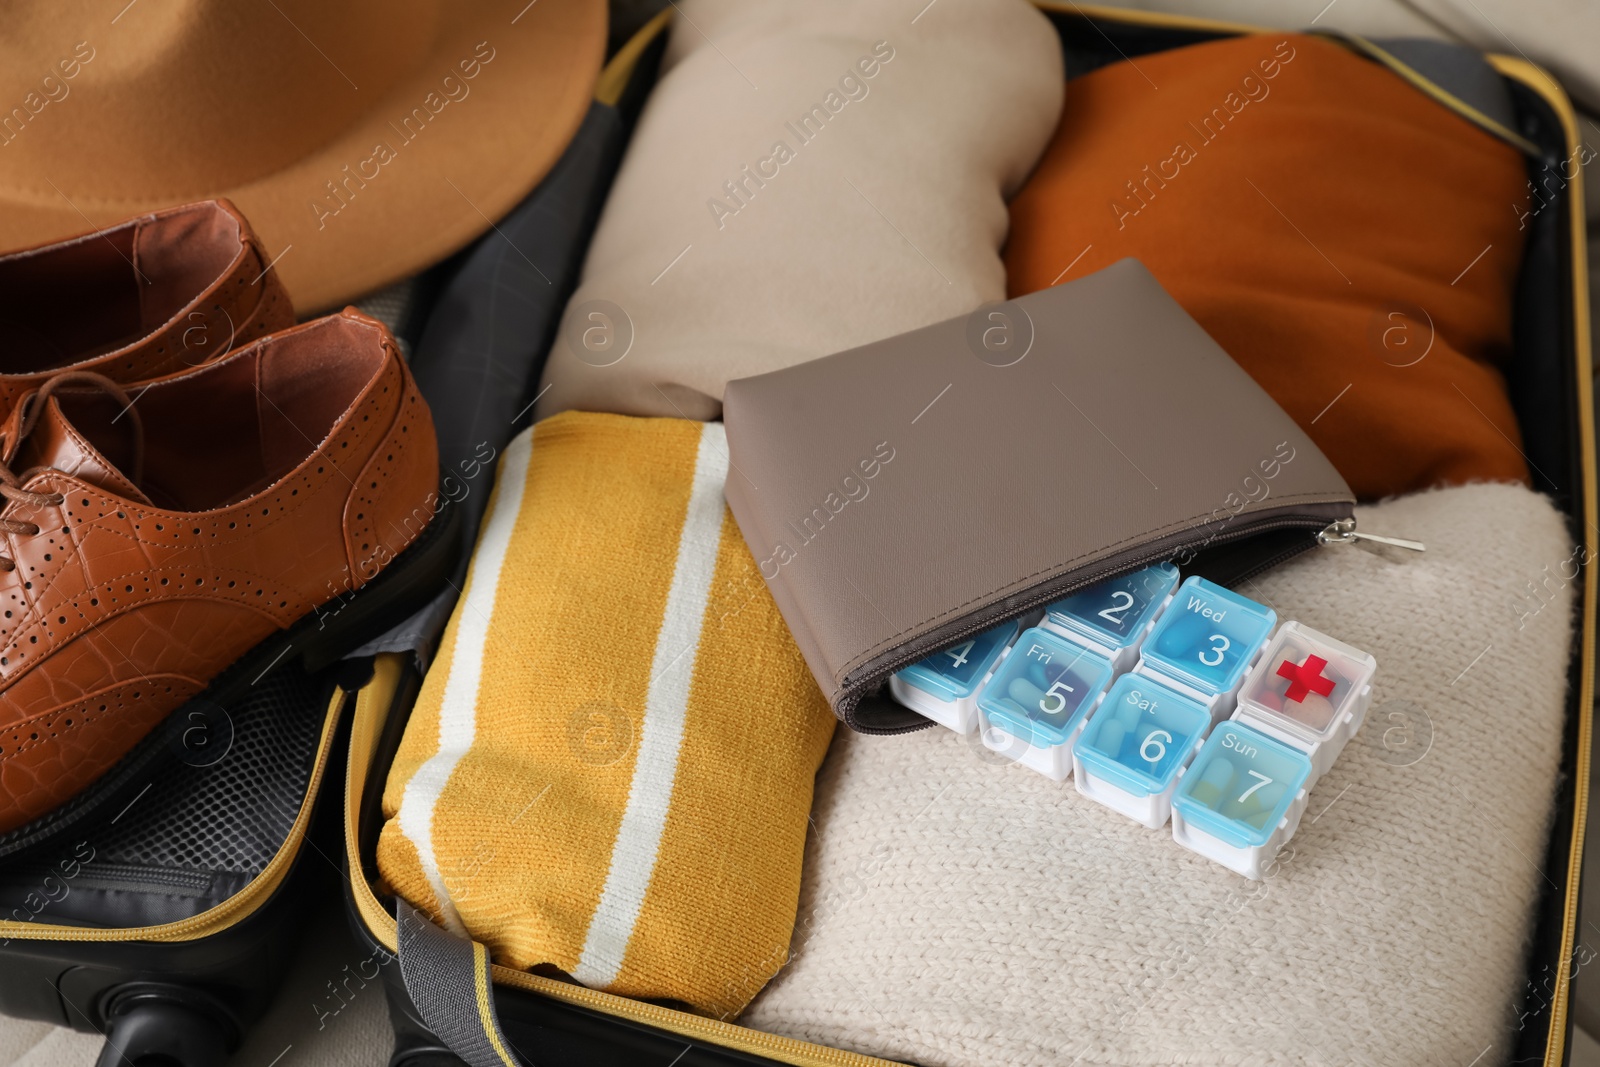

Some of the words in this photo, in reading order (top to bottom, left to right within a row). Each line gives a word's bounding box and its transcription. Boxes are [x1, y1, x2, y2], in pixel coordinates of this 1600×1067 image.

[1098, 590, 1134, 625] 2
[1186, 595, 1227, 623] Wed
[944, 640, 976, 669] 4
[1026, 643, 1055, 665] Fri
[1198, 634, 1231, 666] 3
[1039, 681, 1075, 715] 5
[1126, 690, 1159, 715] Sat
[1139, 730, 1173, 763] 6
[1221, 733, 1258, 759] Sun
[1237, 769, 1274, 804] 7
